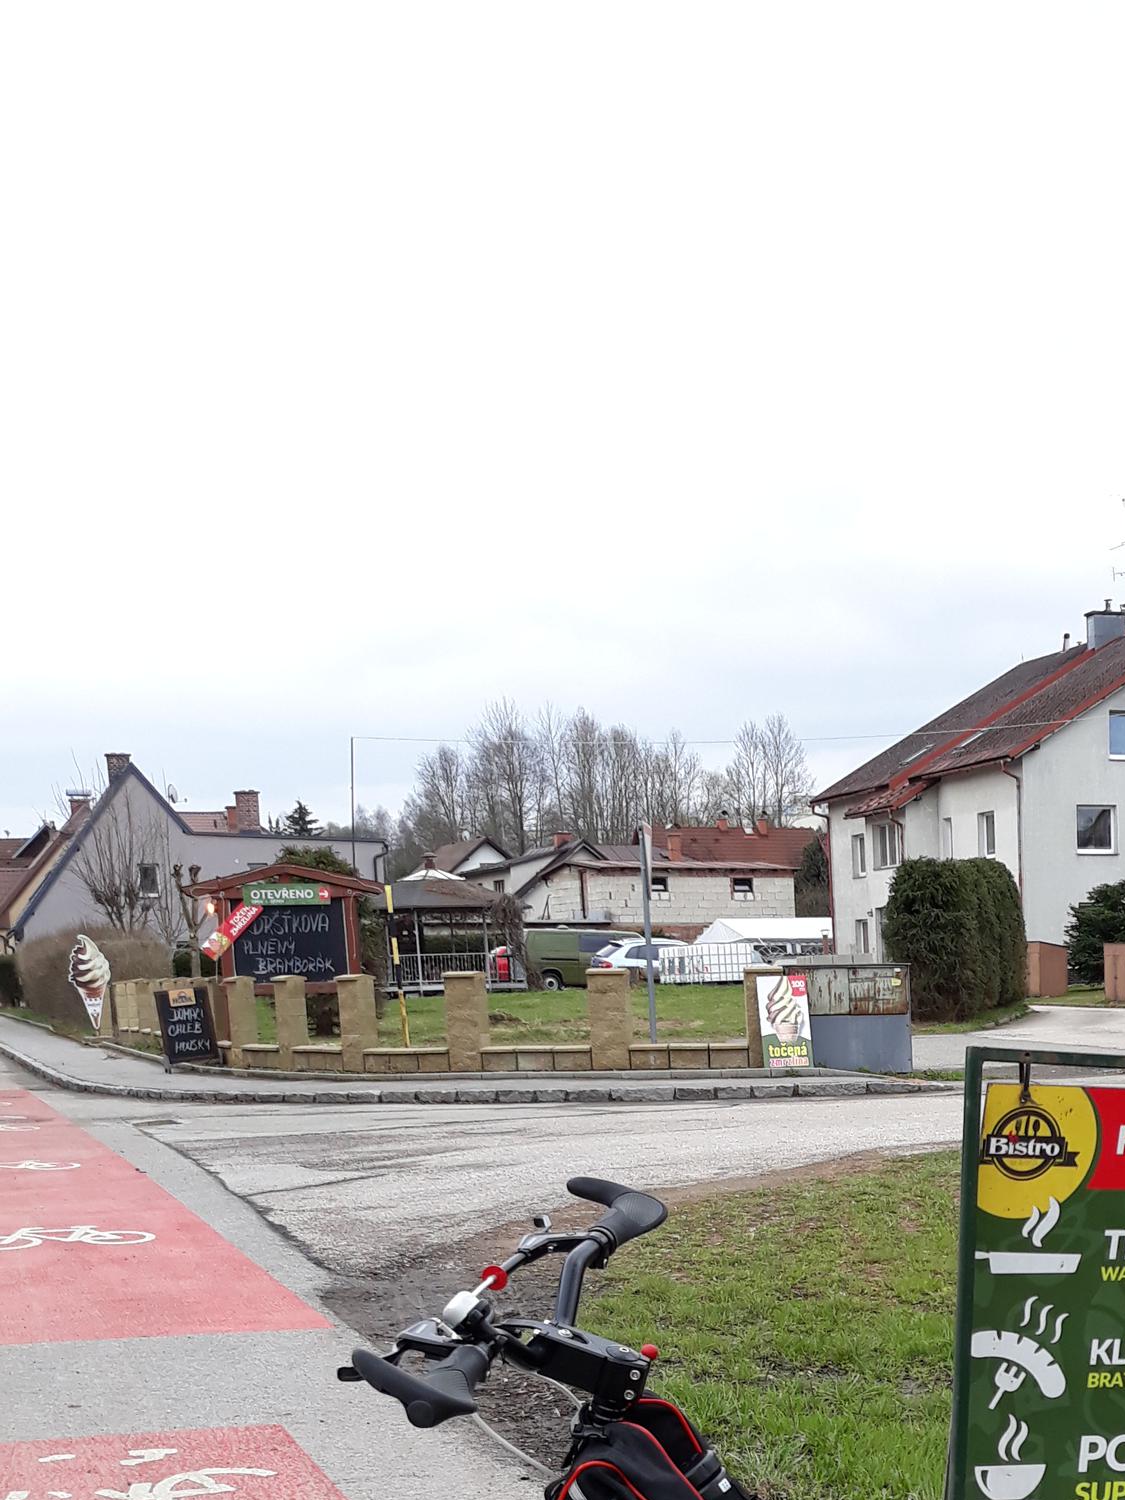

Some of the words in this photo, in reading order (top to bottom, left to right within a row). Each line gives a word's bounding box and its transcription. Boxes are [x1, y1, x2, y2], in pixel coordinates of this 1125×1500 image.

[250, 888, 314, 899] OTEVŘENO
[768, 1041, 808, 1058] točená
[769, 1056, 810, 1068] zmrzlina
[988, 1136, 1061, 1158] Bistro
